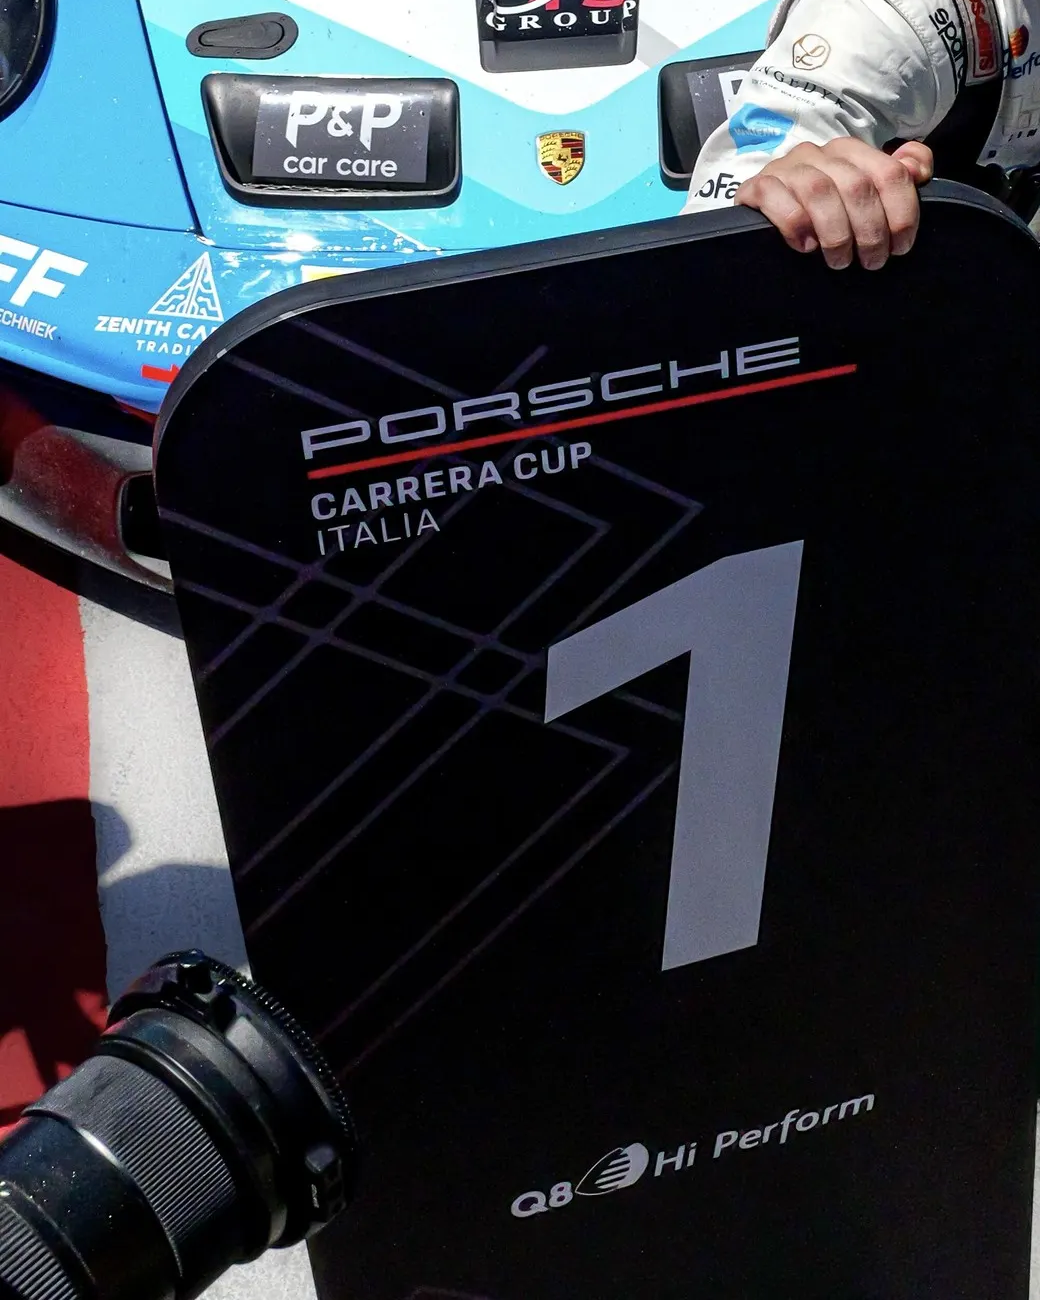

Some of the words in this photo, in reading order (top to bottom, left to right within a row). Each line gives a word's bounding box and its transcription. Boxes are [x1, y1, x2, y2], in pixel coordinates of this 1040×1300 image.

[285, 89, 403, 151] P&P
[283, 154, 329, 175] car
[340, 156, 398, 178] care
[95, 315, 176, 338] ZENITH
[136, 339, 200, 357] TRADI
[300, 335, 801, 460] PORSCHE
[311, 459, 503, 521] CARRERA
[513, 441, 593, 480] CUP
[317, 508, 440, 556] ITALIA
[544, 539, 805, 972] 1
[510, 1180, 574, 1218] Q8
[654, 1141, 698, 1177] Hi
[713, 1093, 875, 1159] Perform
